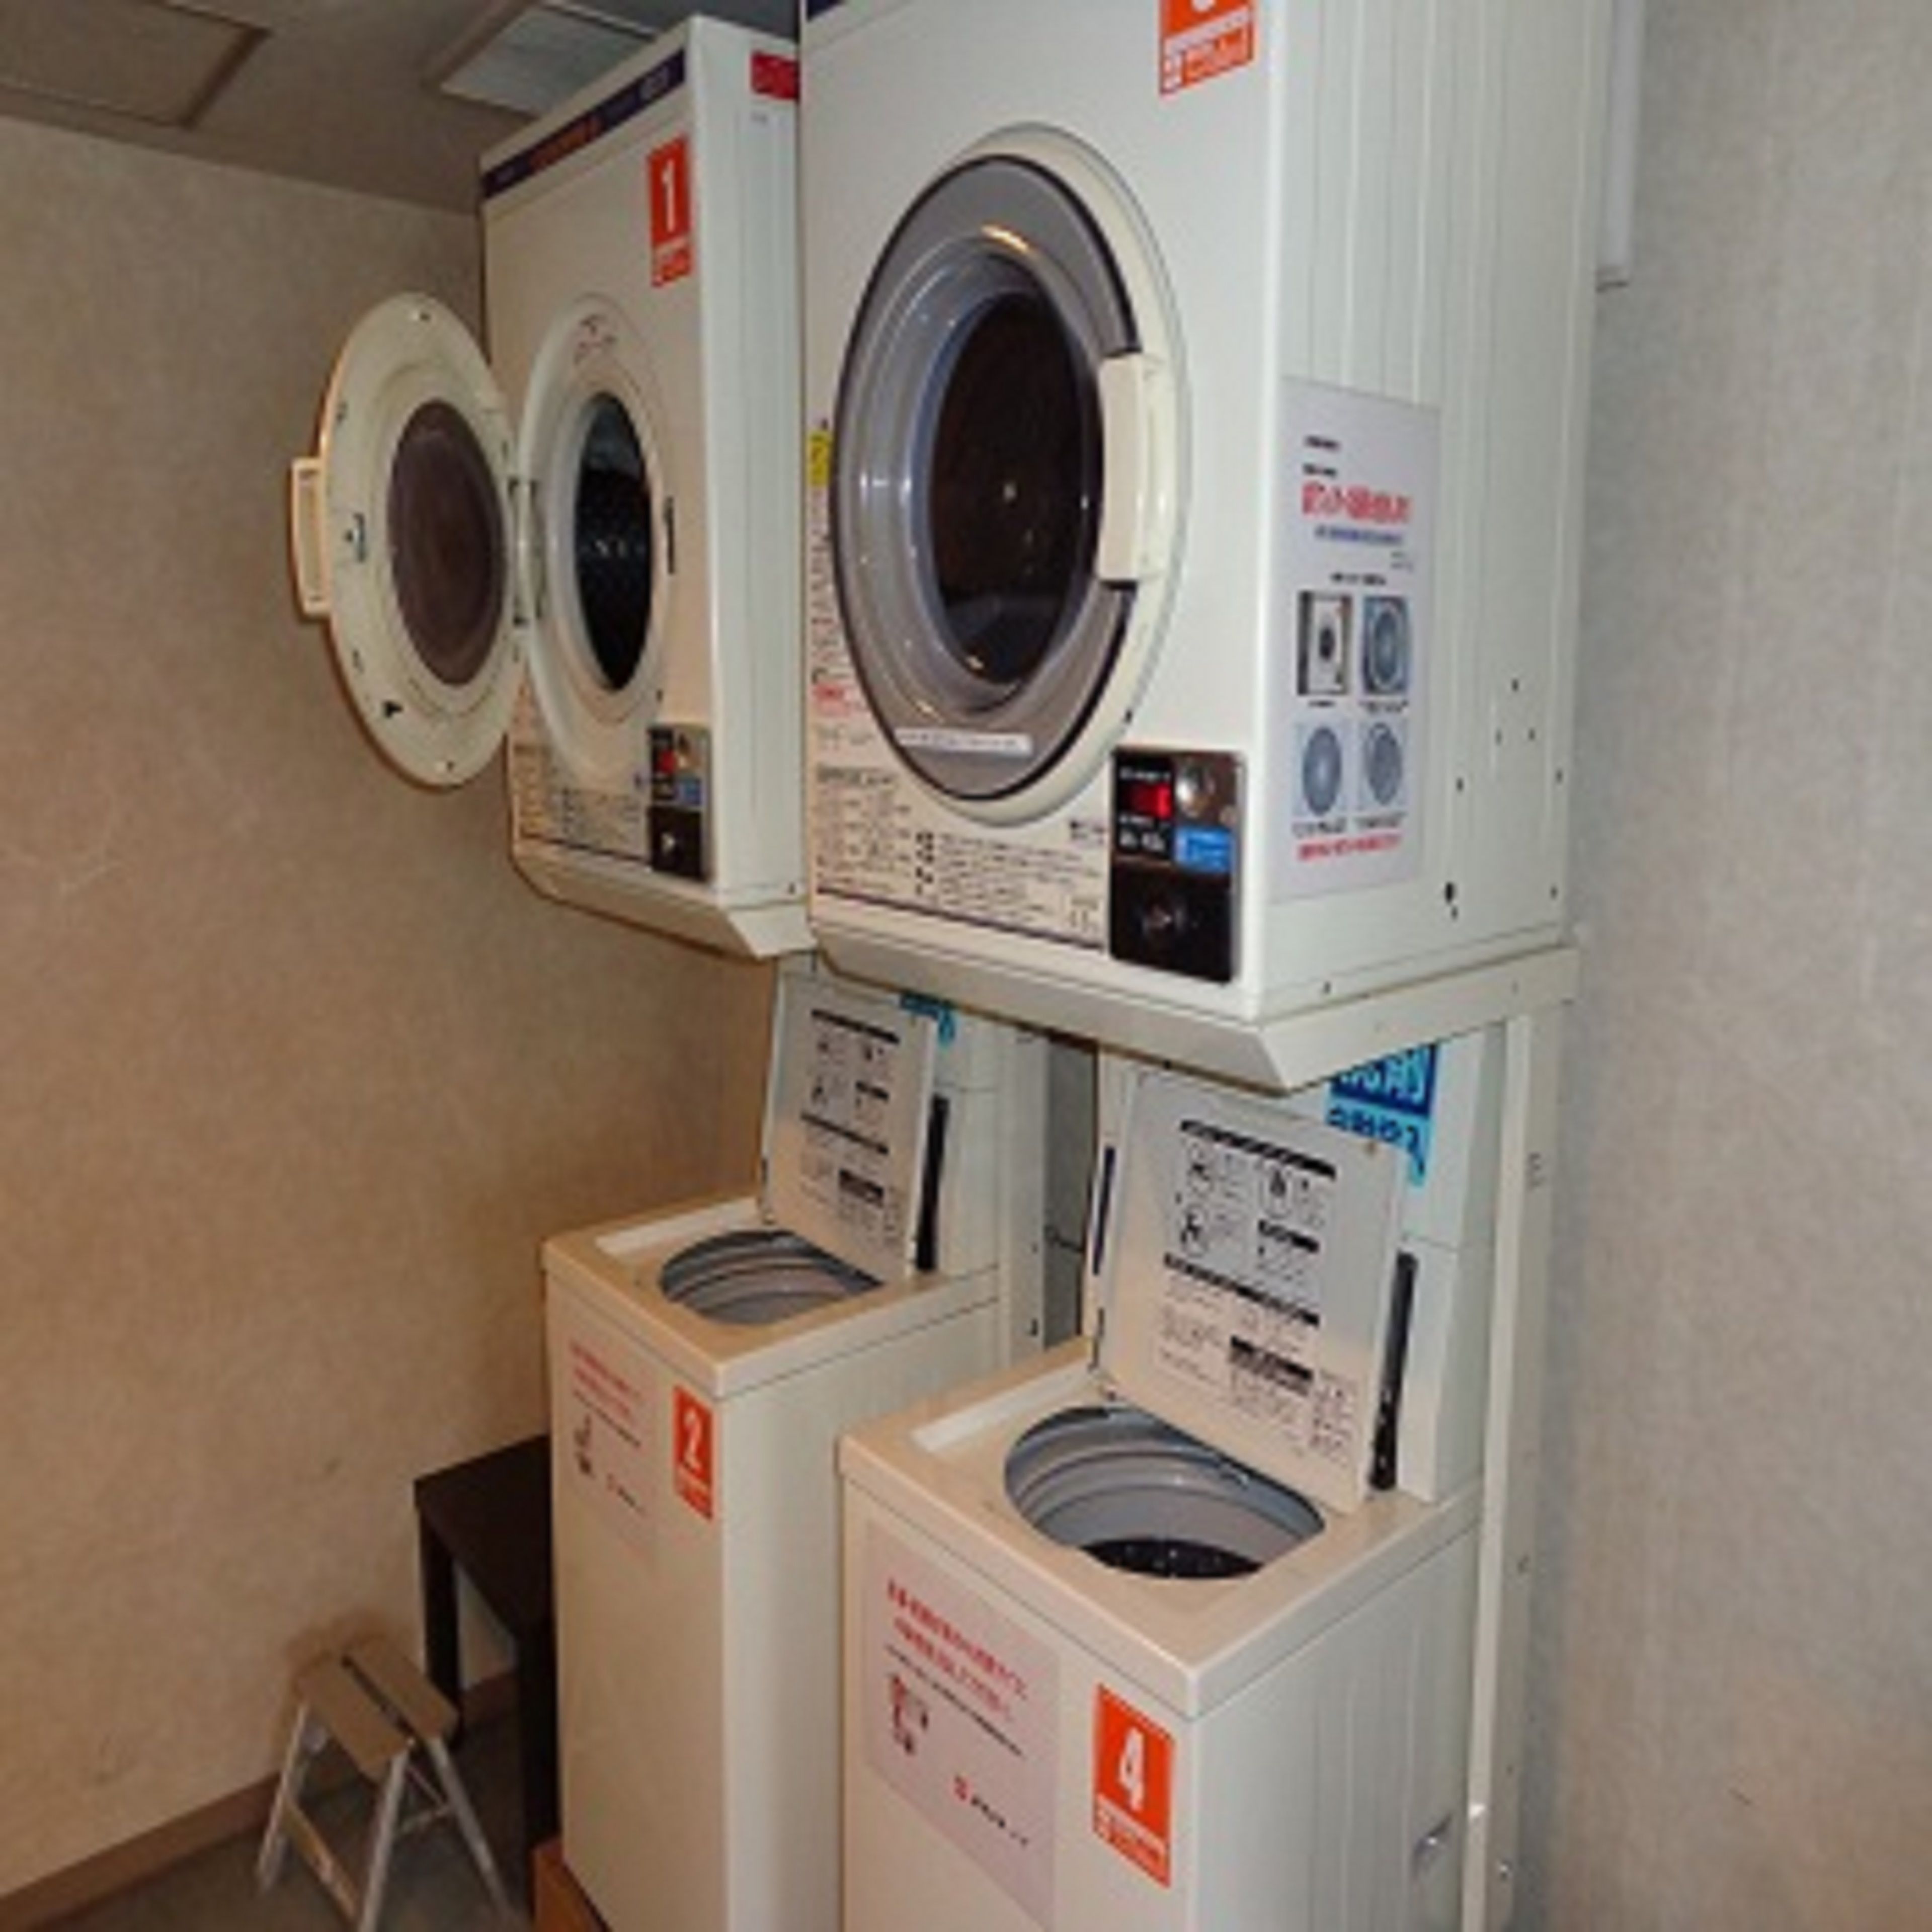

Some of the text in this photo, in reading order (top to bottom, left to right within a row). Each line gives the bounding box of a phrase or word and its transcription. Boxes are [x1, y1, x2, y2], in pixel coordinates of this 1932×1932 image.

[662, 158, 675, 233] 1
[683, 1407, 703, 1472] 2
[1118, 1727, 1145, 1812] 4
